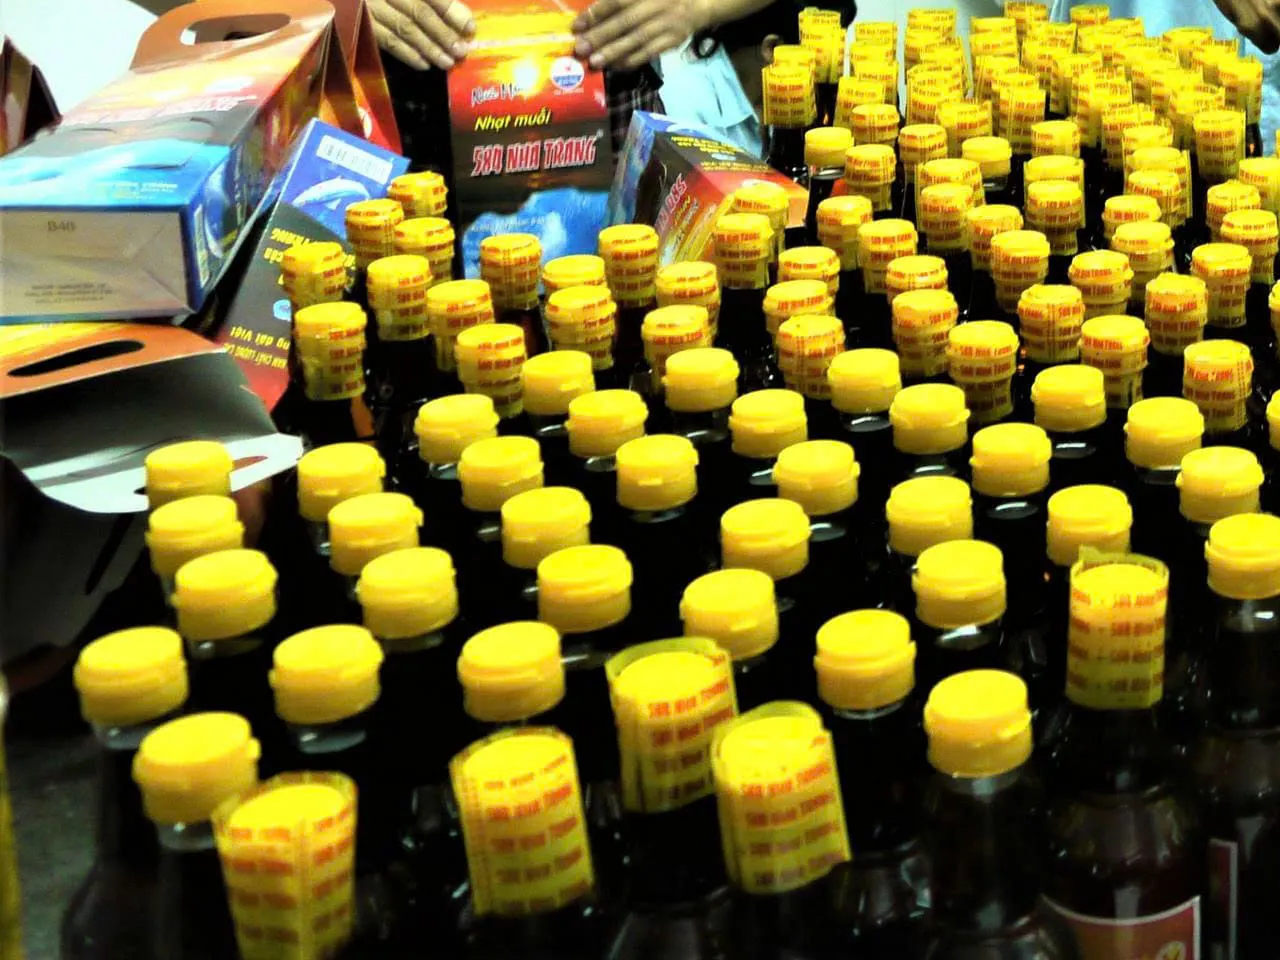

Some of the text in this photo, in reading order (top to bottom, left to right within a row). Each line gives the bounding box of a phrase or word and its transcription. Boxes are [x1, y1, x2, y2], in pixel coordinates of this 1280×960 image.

[474, 114, 511, 132] Nhạt
[471, 135, 598, 177] 584 NHA TRANG
